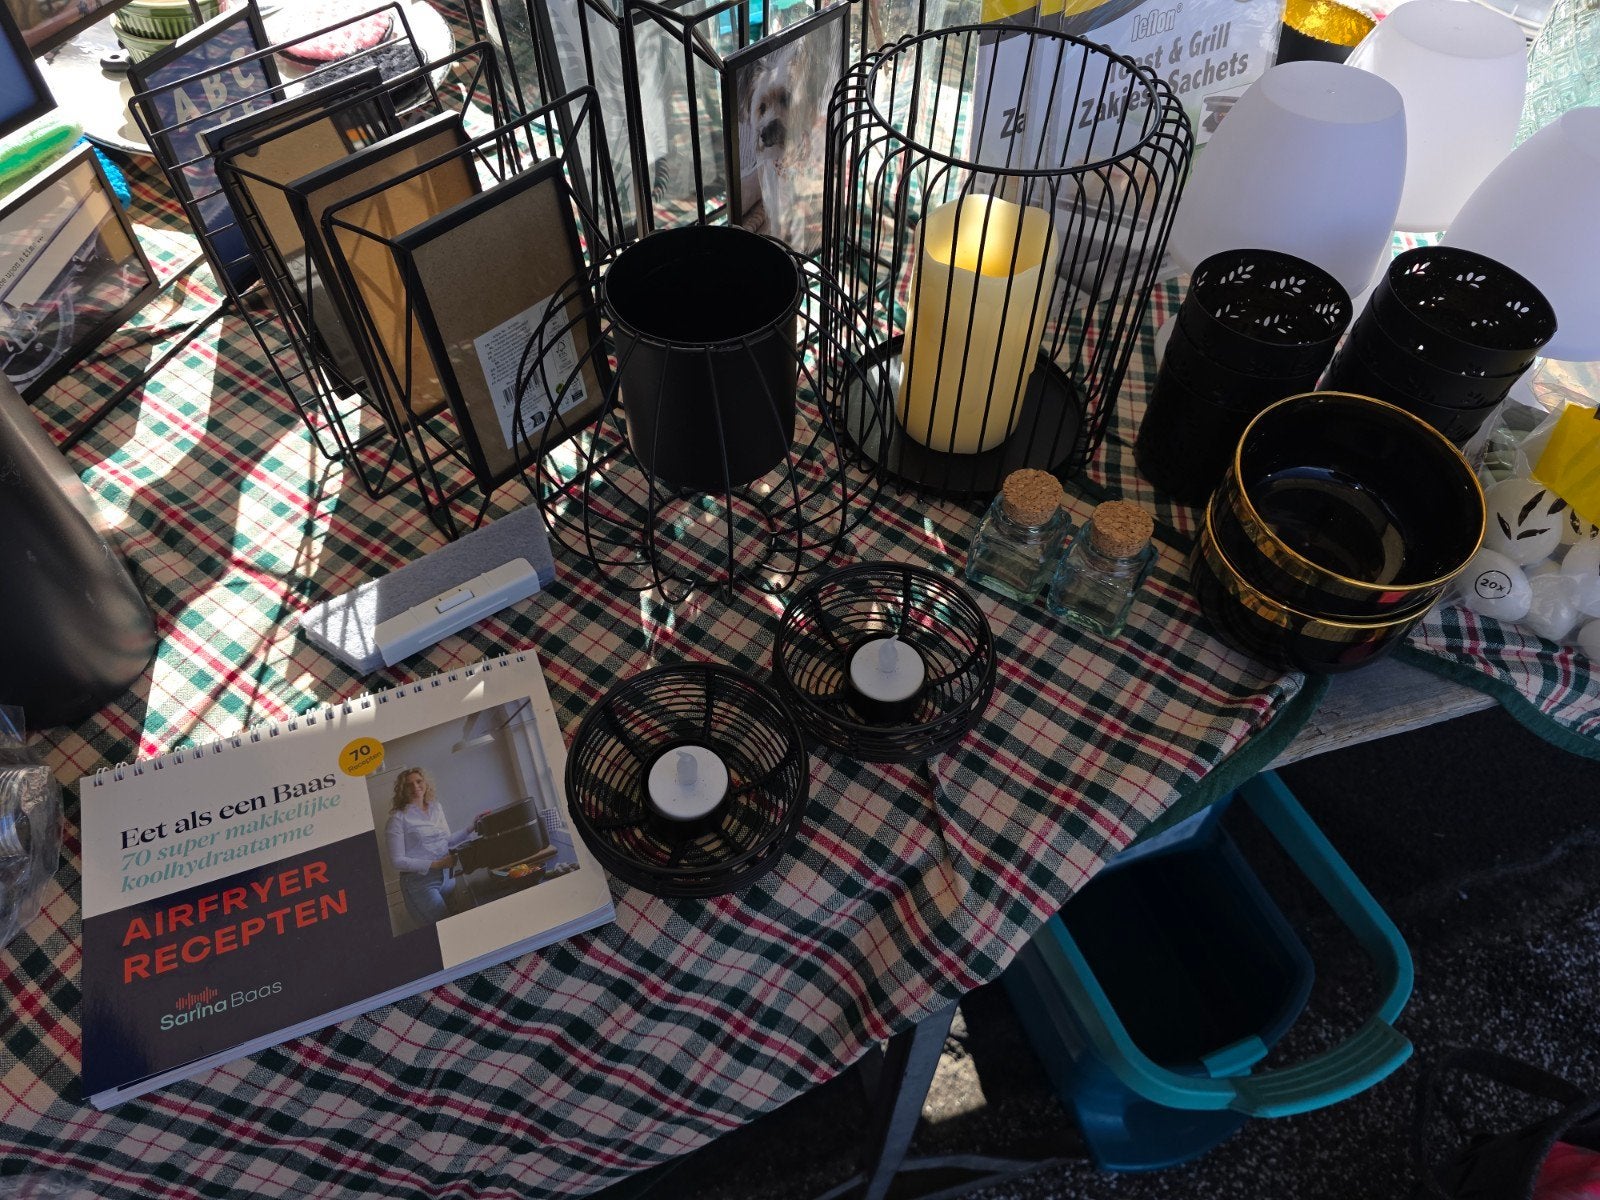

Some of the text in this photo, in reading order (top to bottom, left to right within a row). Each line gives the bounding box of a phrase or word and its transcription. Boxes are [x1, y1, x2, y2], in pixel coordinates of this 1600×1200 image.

[1168, 37, 1183, 65] &
[1188, 21, 1231, 58] Grill
[1167, 52, 1249, 96] Sachets
[1480, 578, 1506, 592] 20x
[348, 752, 382, 772] Recepten
[349, 745, 370, 761] 70
[120, 793, 342, 871] 70 super makkelijke
[121, 773, 337, 849] Eet als een Baas
[121, 823, 315, 893] koolhydraatarme
[122, 861, 330, 947] AIRFRYER
[124, 889, 348, 985] RECEPTEN
[160, 981, 283, 1031] Sarina Baas
